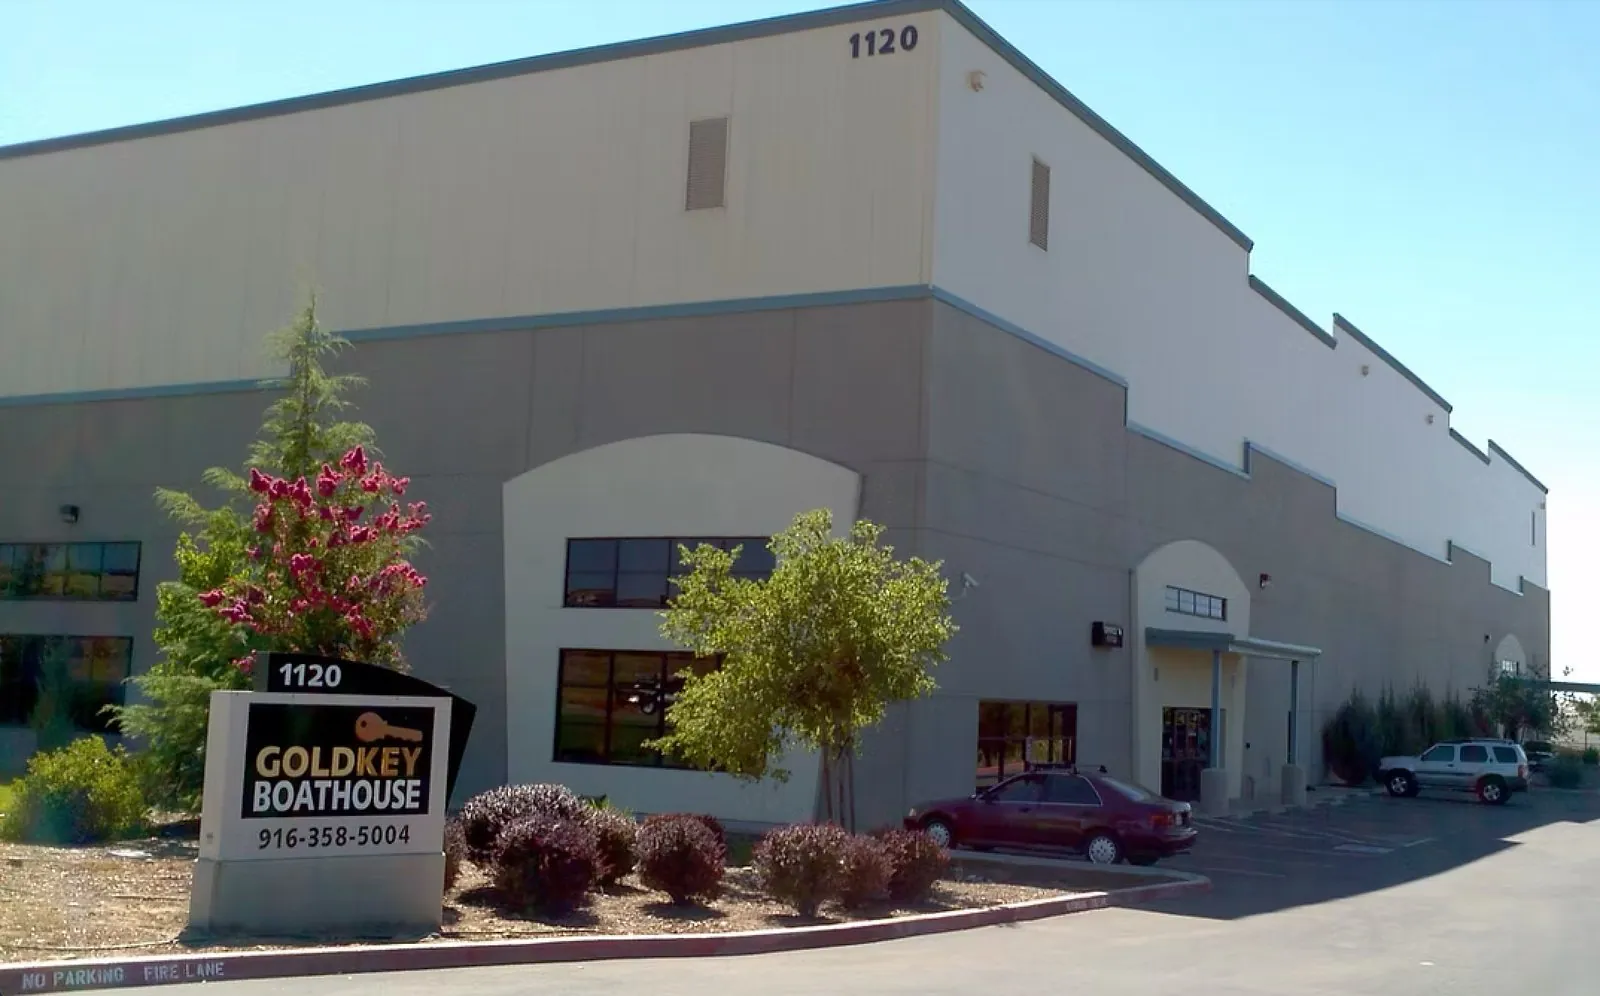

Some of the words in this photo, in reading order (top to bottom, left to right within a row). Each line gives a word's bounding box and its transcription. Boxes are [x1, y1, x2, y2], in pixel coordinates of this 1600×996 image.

[849, 25, 918, 59] 1120
[279, 663, 342, 687] 1120
[256, 746, 422, 777] GOLDKEY
[252, 779, 421, 812] BOATHOUSE
[258, 824, 410, 849] 916-358-5004
[22, 972, 46, 989] NO
[53, 967, 124, 987] PARKING
[143, 964, 179, 981] FIRE
[185, 961, 225, 978] LANE
